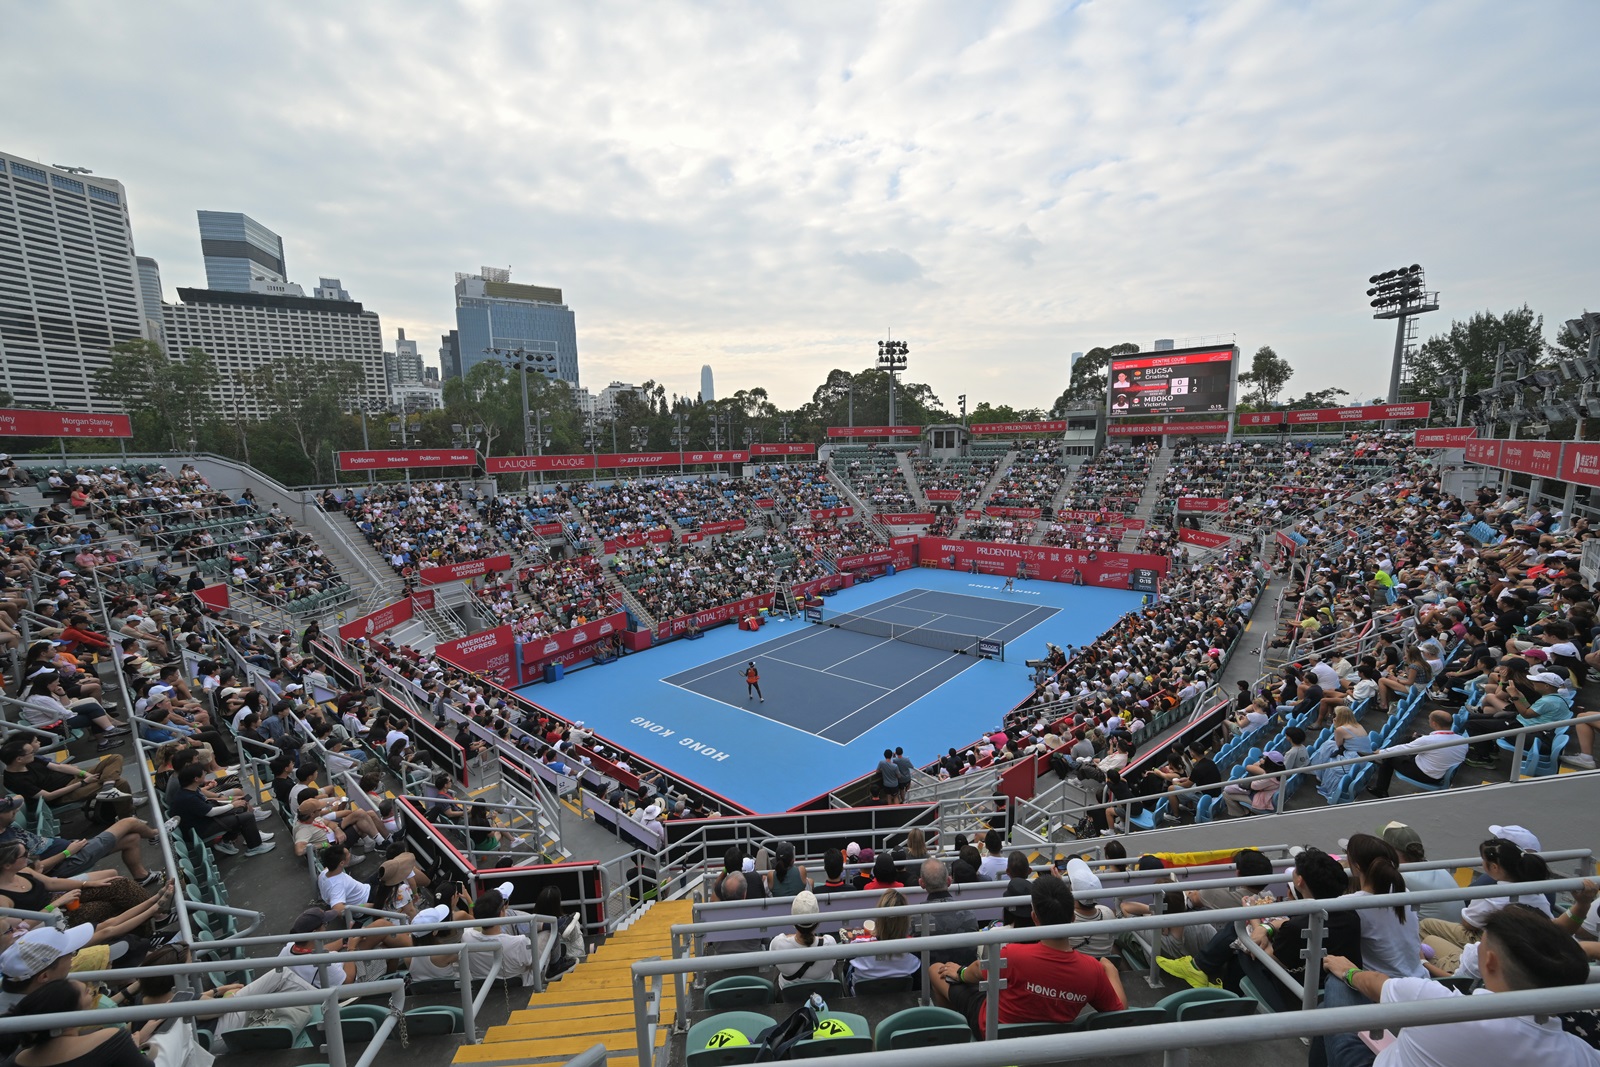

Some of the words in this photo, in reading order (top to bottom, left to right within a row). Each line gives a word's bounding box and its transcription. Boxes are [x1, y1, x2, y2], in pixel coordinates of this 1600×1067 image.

[62, 418, 89, 426] Morgan
[90, 418, 113, 426] Stanley
[499, 460, 537, 468] LALIQUE
[552, 458, 584, 466] LALIQUE
[1196, 536, 1220, 544] XPENG
[977, 547, 1021, 558] PRUDENTIAL
[1037, 552, 1087, 564] 保誠保險
[451, 562, 484, 572] AMERICAN
[456, 567, 485, 577] EXPRESS
[729, 599, 764, 614] 保誠保險
[456, 633, 496, 650] AMERICAN
[463, 639, 497, 654] EXPRESS
[487, 655, 504, 664] HONG
[551, 652, 574, 663] HONG
[488, 659, 505, 669] KONG
[630, 716, 675, 737] KONG
[679, 737, 730, 762] HONG
[1026, 982, 1056, 997] HONG
[1059, 991, 1087, 1002] KONG
